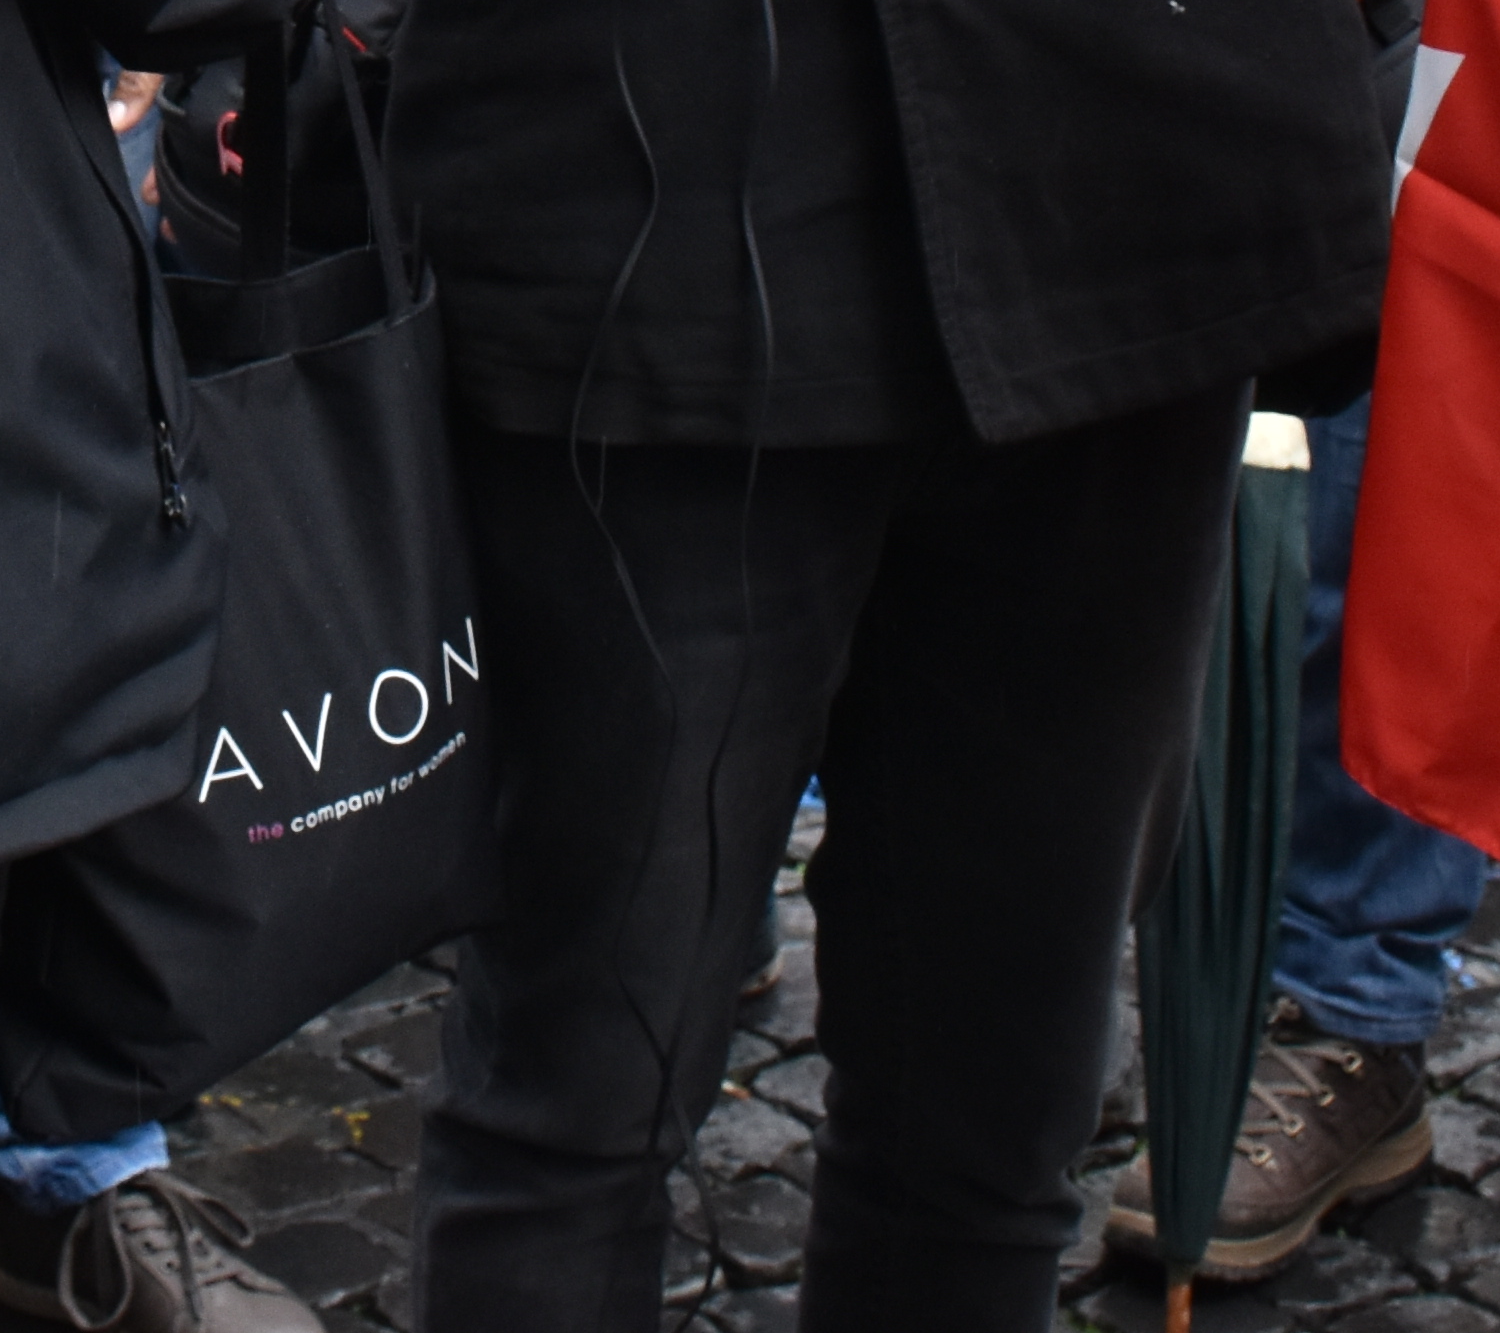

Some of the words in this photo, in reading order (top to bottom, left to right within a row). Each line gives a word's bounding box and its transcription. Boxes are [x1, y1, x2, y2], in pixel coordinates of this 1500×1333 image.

[198, 616, 479, 803] AVON
[248, 821, 285, 844] the
[290, 785, 386, 833] company
[389, 771, 415, 795] for
[418, 731, 467, 779] women
